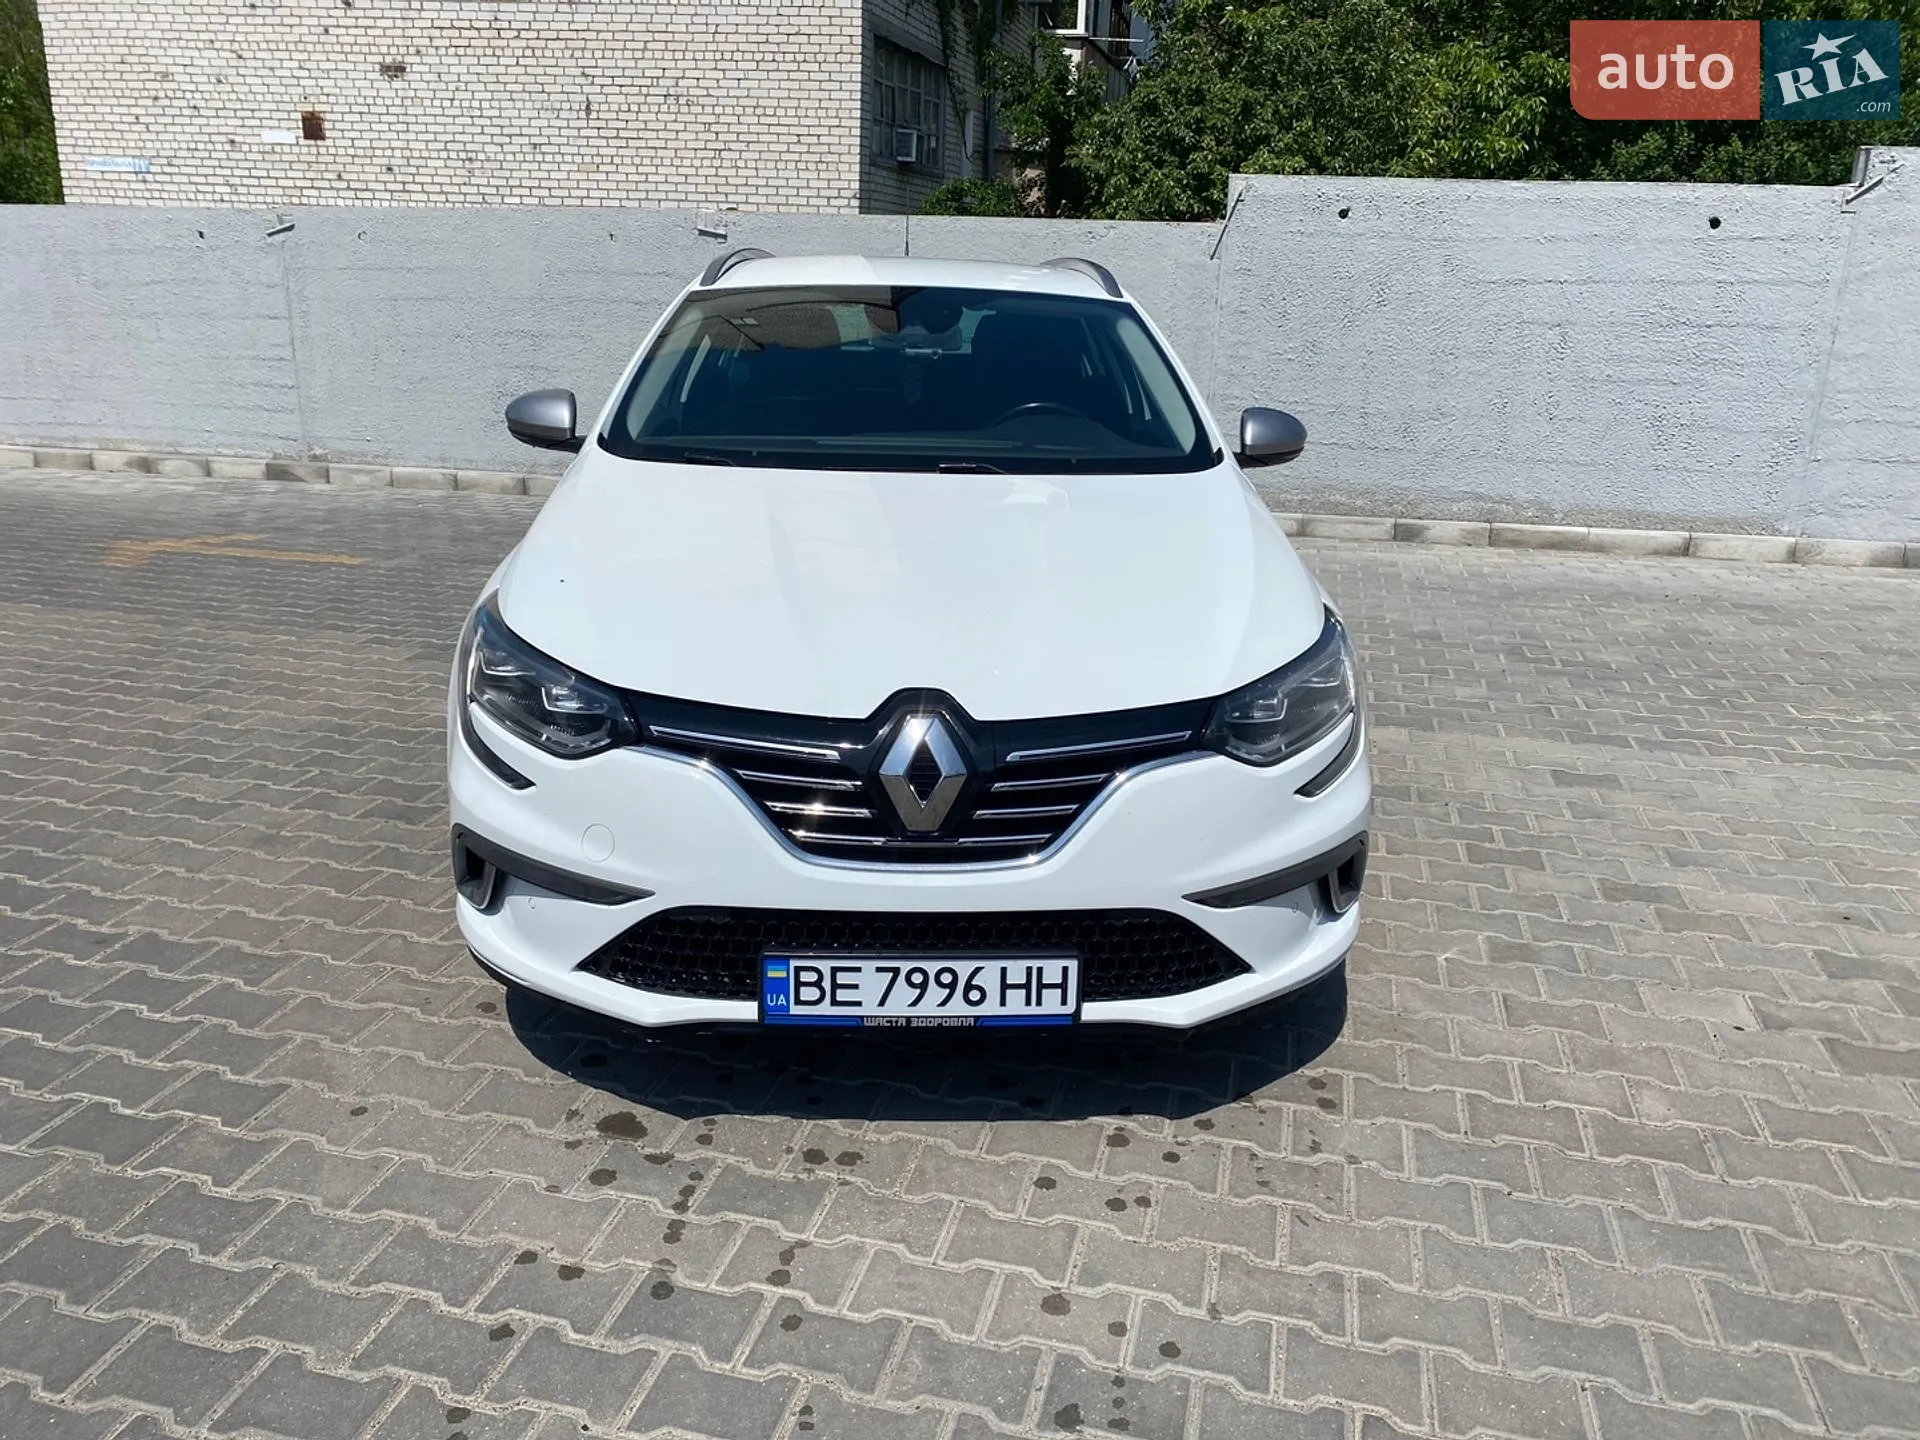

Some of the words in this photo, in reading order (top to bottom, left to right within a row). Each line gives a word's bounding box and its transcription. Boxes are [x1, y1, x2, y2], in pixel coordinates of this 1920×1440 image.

[766, 993, 787, 1007] UA
[793, 965, 862, 1007] BE
[875, 965, 987, 1007] 7996
[999, 965, 1069, 1007] HH
